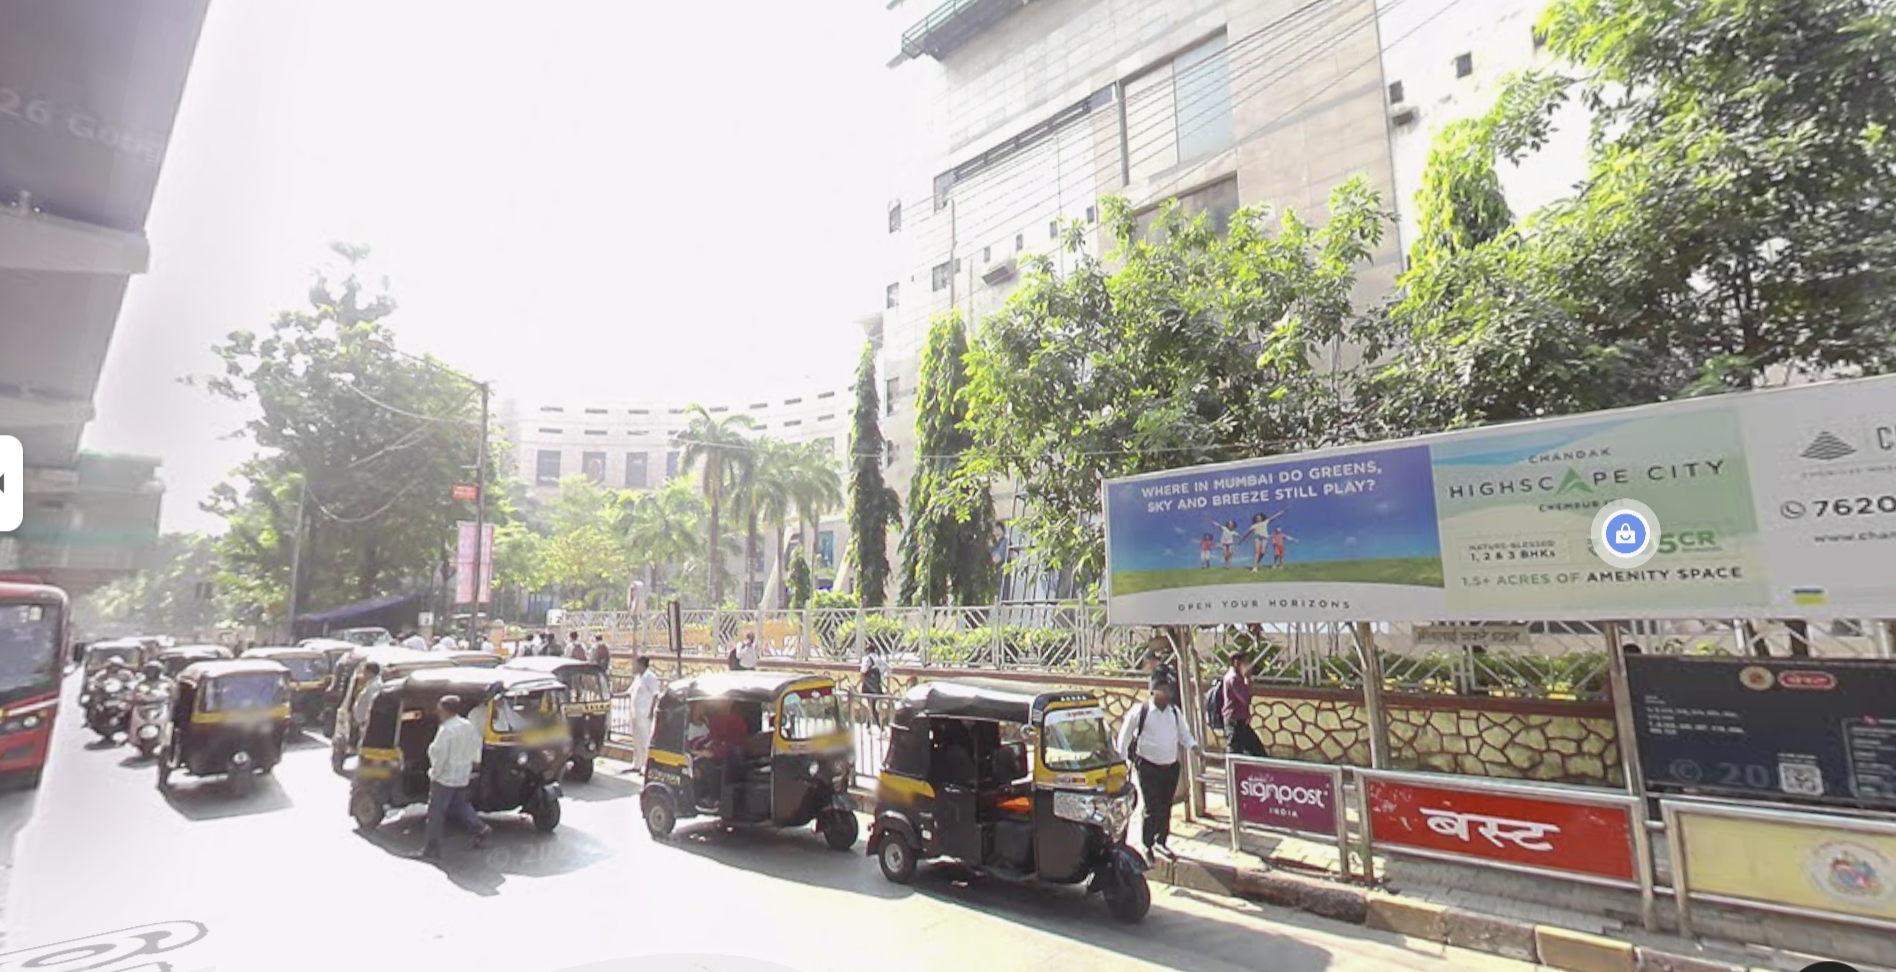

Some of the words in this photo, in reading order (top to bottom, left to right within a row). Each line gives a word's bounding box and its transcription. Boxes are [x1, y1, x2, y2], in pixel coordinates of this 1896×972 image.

[1528, 447, 1612, 464] CHANDAK
[1141, 482, 1189, 498] WHERE
[1194, 481, 1208, 493] IN
[1213, 472, 1273, 490] MUMBAI
[1278, 469, 1303, 483] DO
[1309, 460, 1382, 480] GREENS,
[1647, 459, 1724, 481] CITY
[1147, 498, 1172, 513] SKY
[1177, 496, 1207, 510] AND
[1212, 489, 1269, 507] BREEZE
[1275, 486, 1318, 501] STILL
[1323, 479, 1376, 496] PLAY?
[1470, 552, 1480, 562] 1,
[1484, 552, 1490, 561] 2
[1495, 551, 1503, 560] &
[1508, 551, 1515, 560] 3
[1520, 549, 1556, 559] BHKs
[1496, 573, 1551, 586] ACRES
[1556, 572, 1580, 584] OF
[1586, 569, 1670, 583] AMENITY
[1677, 566, 1743, 581] SPACE
[1177, 602, 1212, 612] OPEN
[1221, 600, 1259, 609] YOUR
[1269, 599, 1350, 610] HORIZONS
[1240, 779, 1326, 808] signpost
[1268, 807, 1299, 818] INDIA
[1418, 806, 1562, 852] बस्ट
